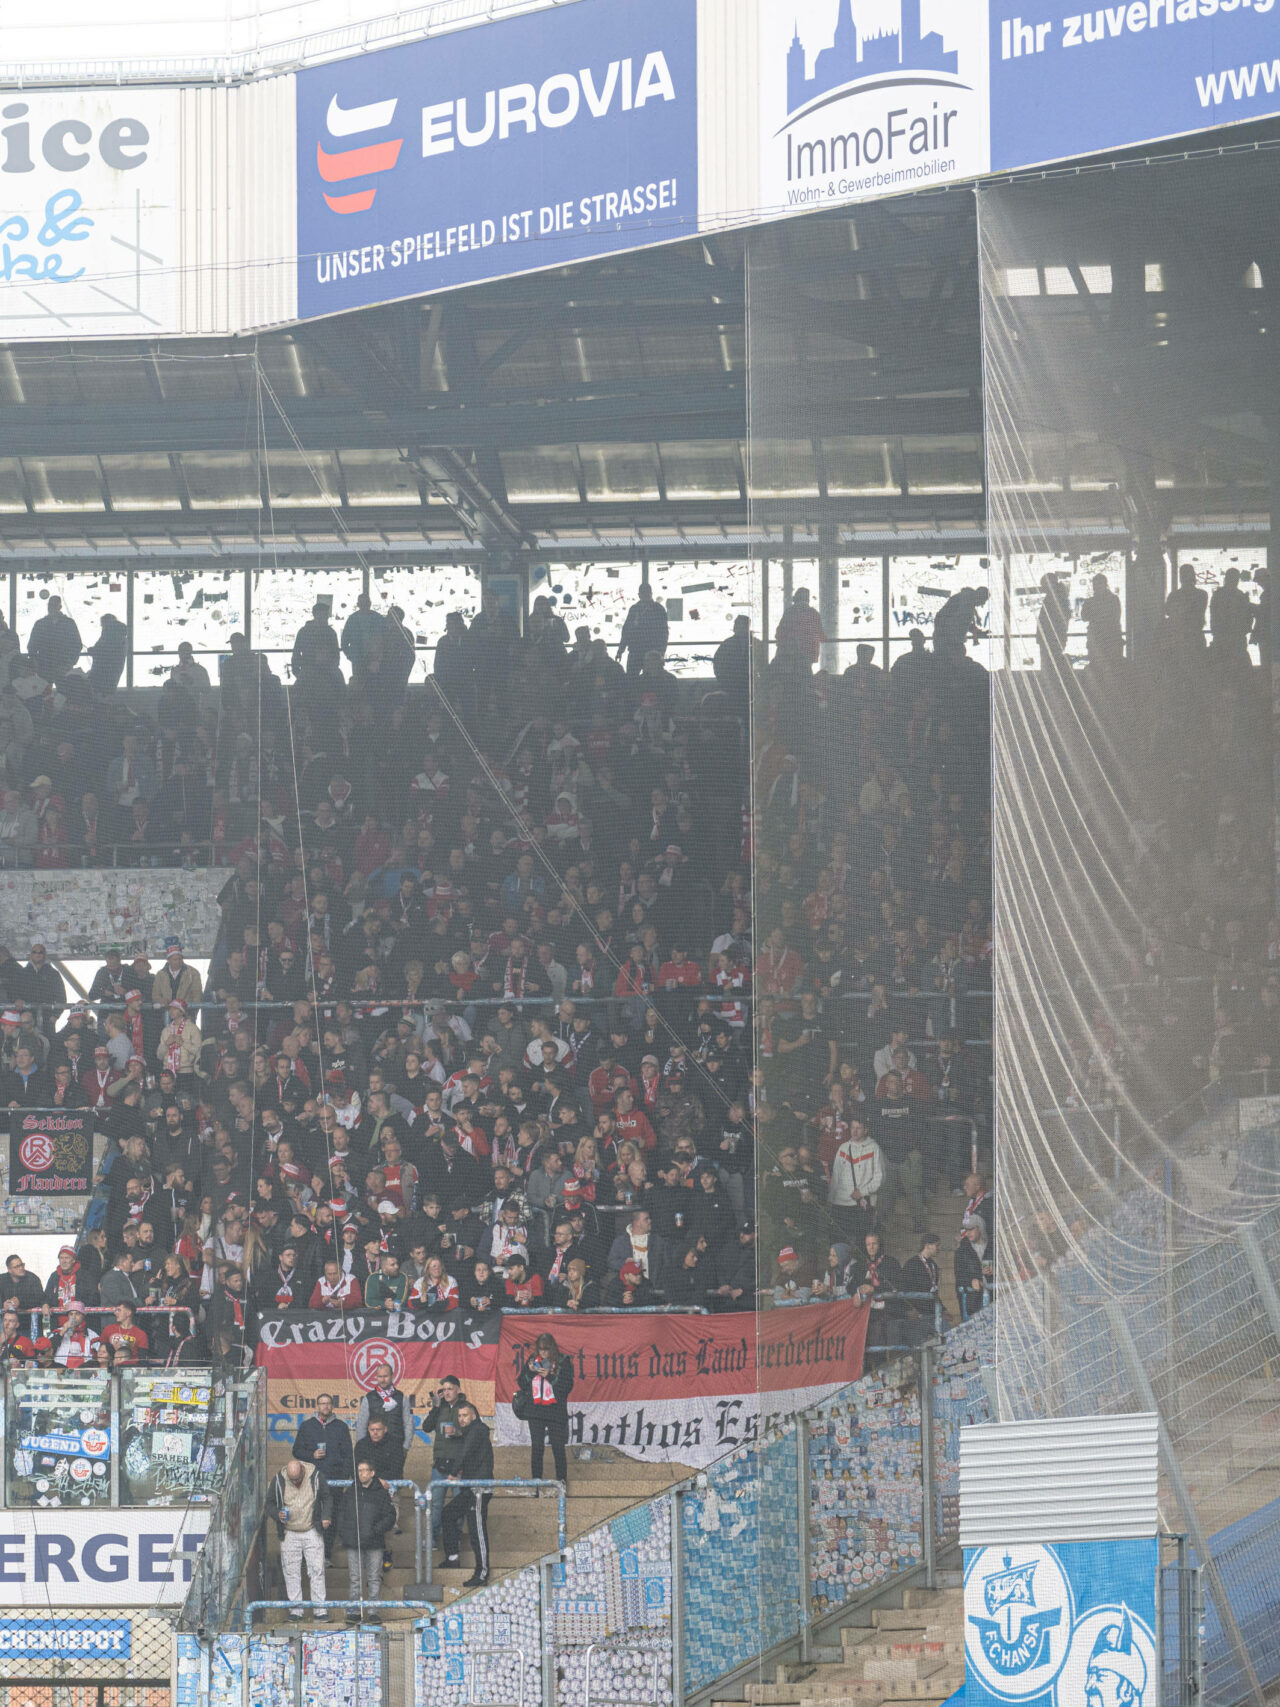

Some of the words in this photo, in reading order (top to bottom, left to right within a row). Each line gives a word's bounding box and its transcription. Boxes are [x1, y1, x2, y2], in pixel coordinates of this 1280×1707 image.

[1001, 17, 1051, 61] Ihr
[421, 50, 675, 158] EUROVIA
[787, 101, 957, 182] ImmoFair
[827, 183, 836, 197] &
[838, 158, 956, 196] Gewerbeimmobilien
[38, 188, 96, 238] &
[317, 241, 385, 284] UNSER
[390, 219, 496, 267] SPIELFELD
[501, 211, 533, 243] IST
[539, 201, 574, 238] DIE
[579, 178, 679, 227] STRASSE!
[22, 1115, 83, 1131] Sektion
[16, 1174, 87, 1192] Flandern
[648, 1345, 687, 1378] das
[695, 1337, 748, 1377] Land
[22, 1436, 80, 1453] JUGEND
